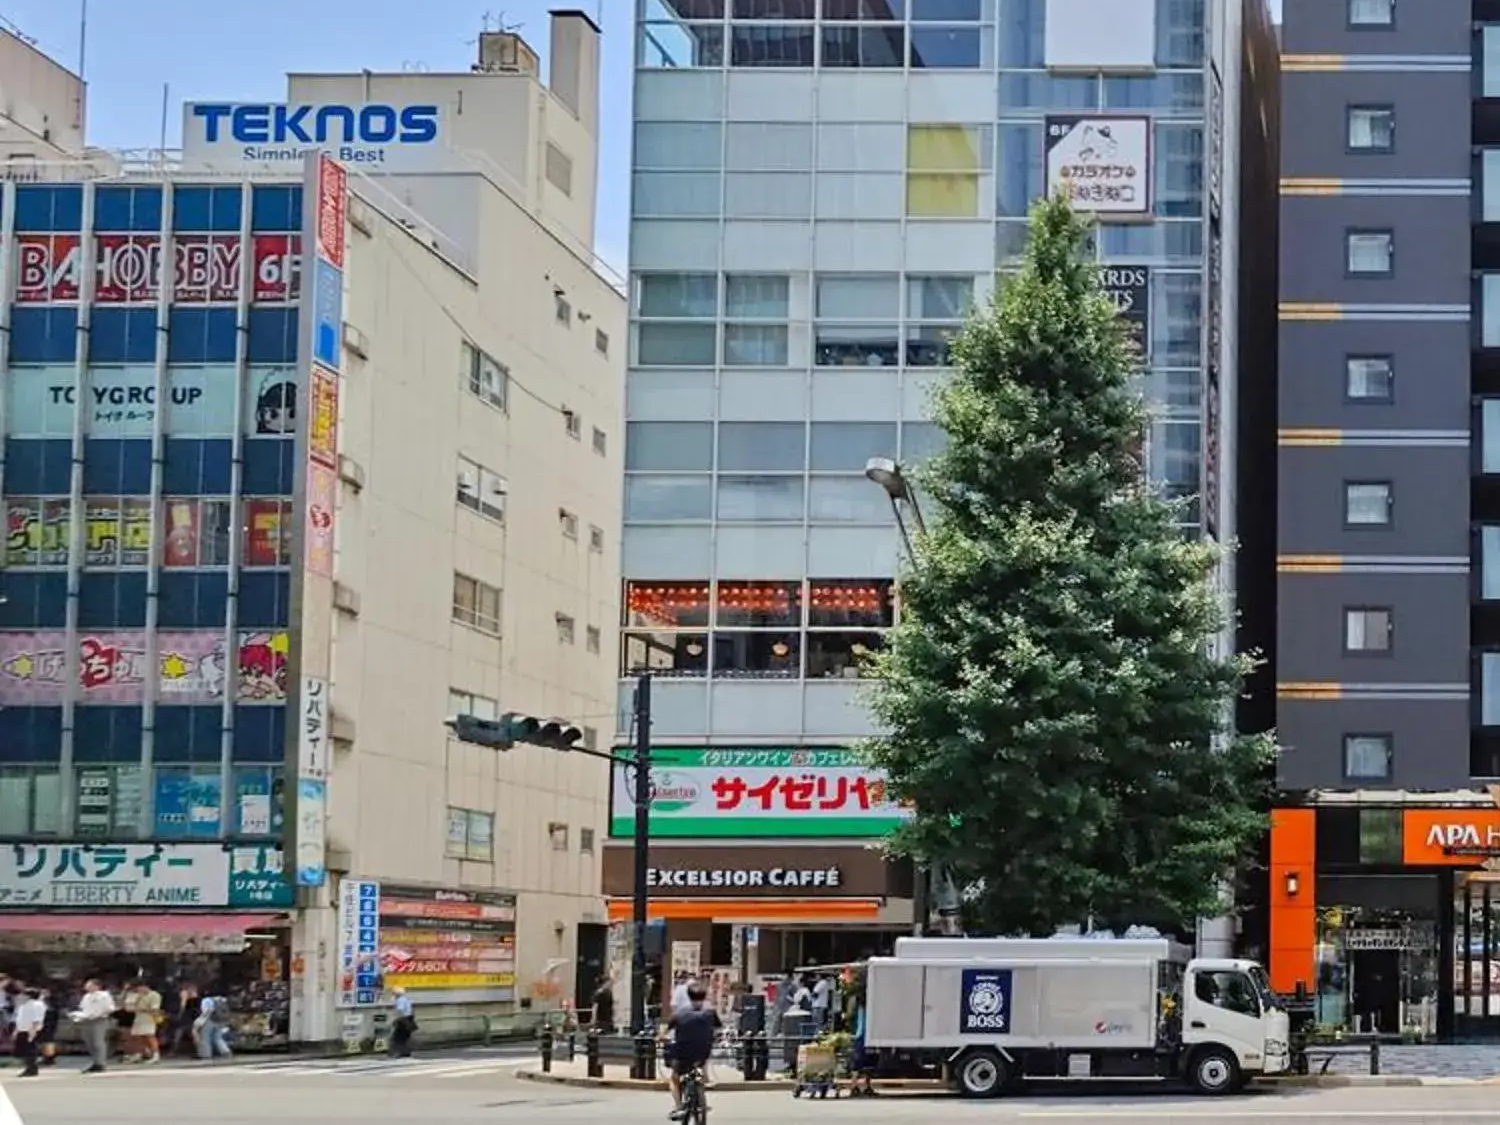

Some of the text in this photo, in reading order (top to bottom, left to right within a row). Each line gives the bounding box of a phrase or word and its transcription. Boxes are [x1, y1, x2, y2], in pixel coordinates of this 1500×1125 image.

[193, 105, 438, 143] TEKNOS
[339, 148, 385, 163] Best
[306, 680, 322, 766] リバティー
[1426, 824, 1480, 846] APA
[14, 846, 193, 878] リバティー
[646, 866, 839, 886] EXCELSIOR CAFFÉ
[51, 886, 136, 903] LIBERTY
[145, 887, 200, 903] ANIME
[967, 1014, 1004, 1028] BOSS
